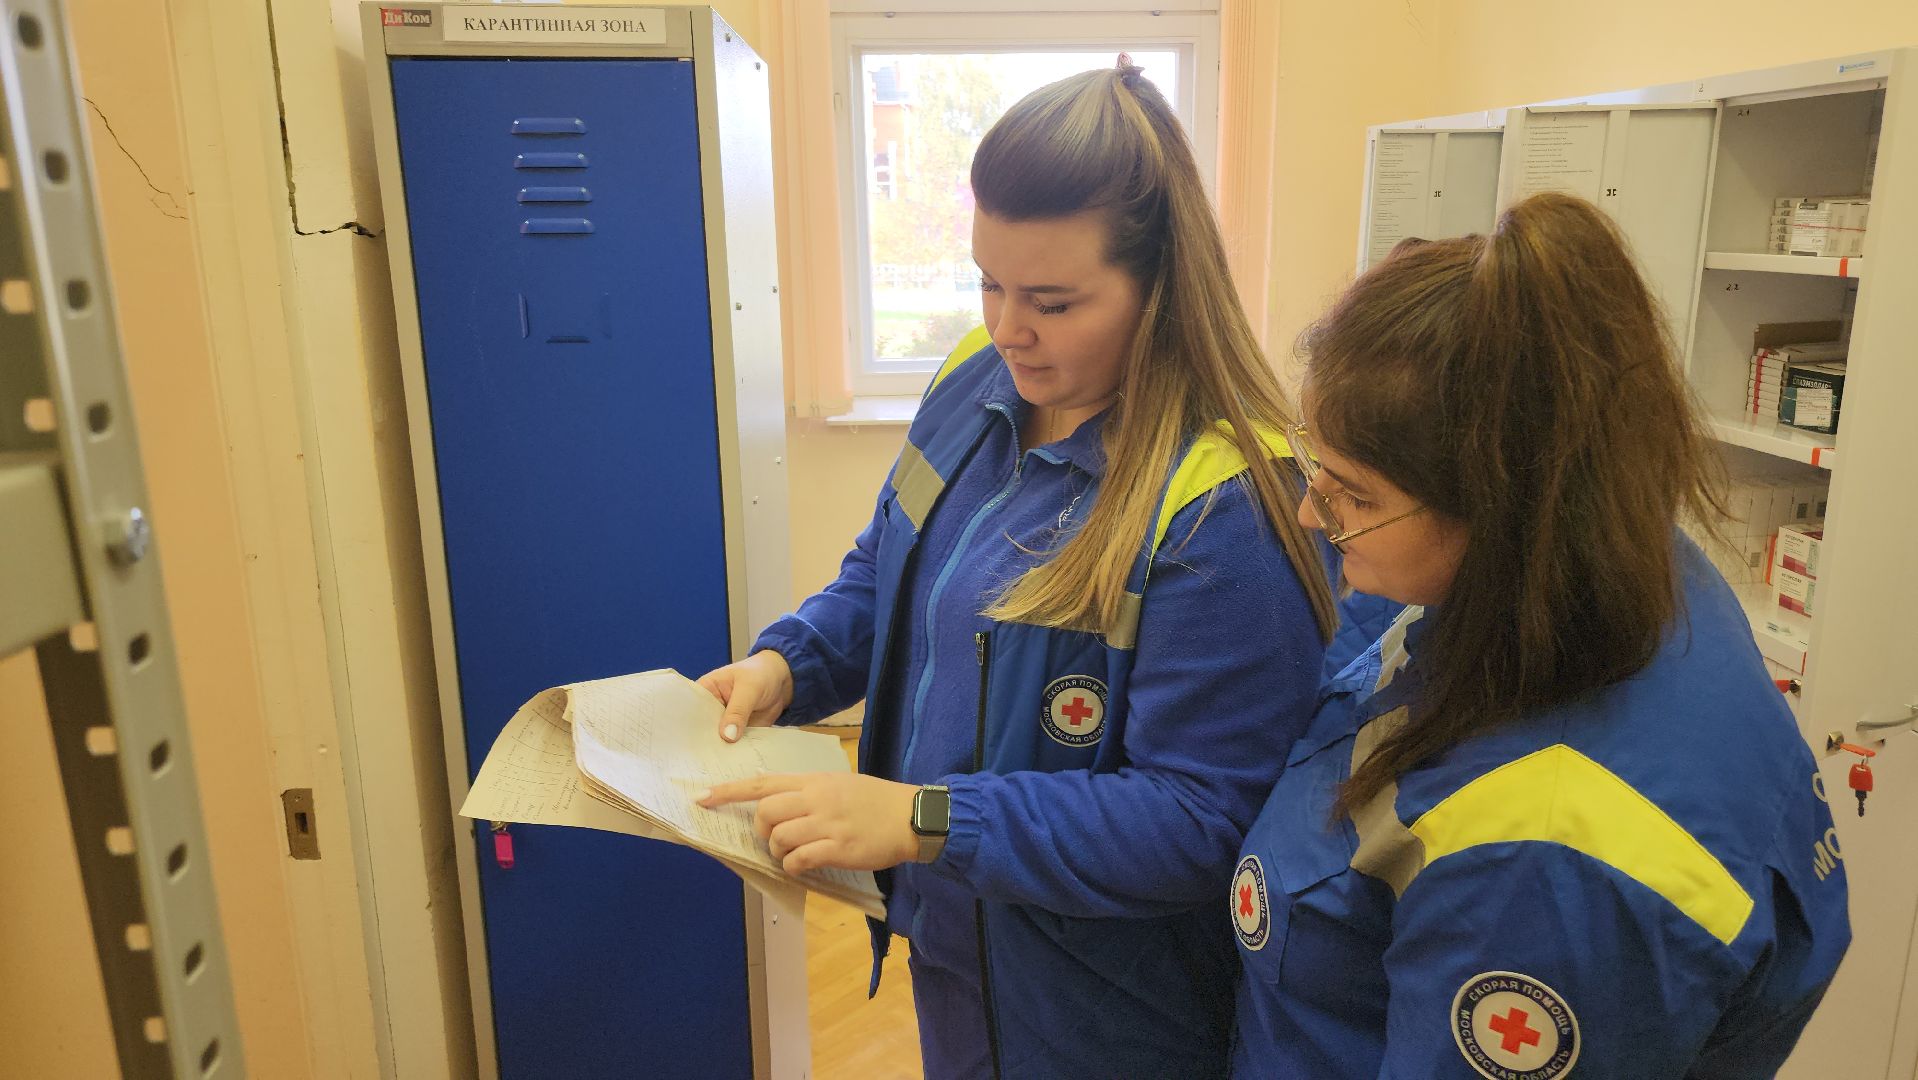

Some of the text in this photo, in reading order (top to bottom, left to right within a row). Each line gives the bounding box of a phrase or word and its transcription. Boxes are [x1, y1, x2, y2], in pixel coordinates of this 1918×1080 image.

[384, 11, 430, 25] ДиКом
[464, 17, 646, 33] КАРАНТИННАЯ ЗОНА
[1048, 680, 1077, 700] СКОРАЯ
[1043, 706, 1082, 743] МОСКОВСКАЯ
[1469, 980, 1572, 1036] СКОРАЯ ПОМОЩЬ
[1460, 1009, 1569, 1080] МОСКОВСКАЯ ОБЛАСТЬ
